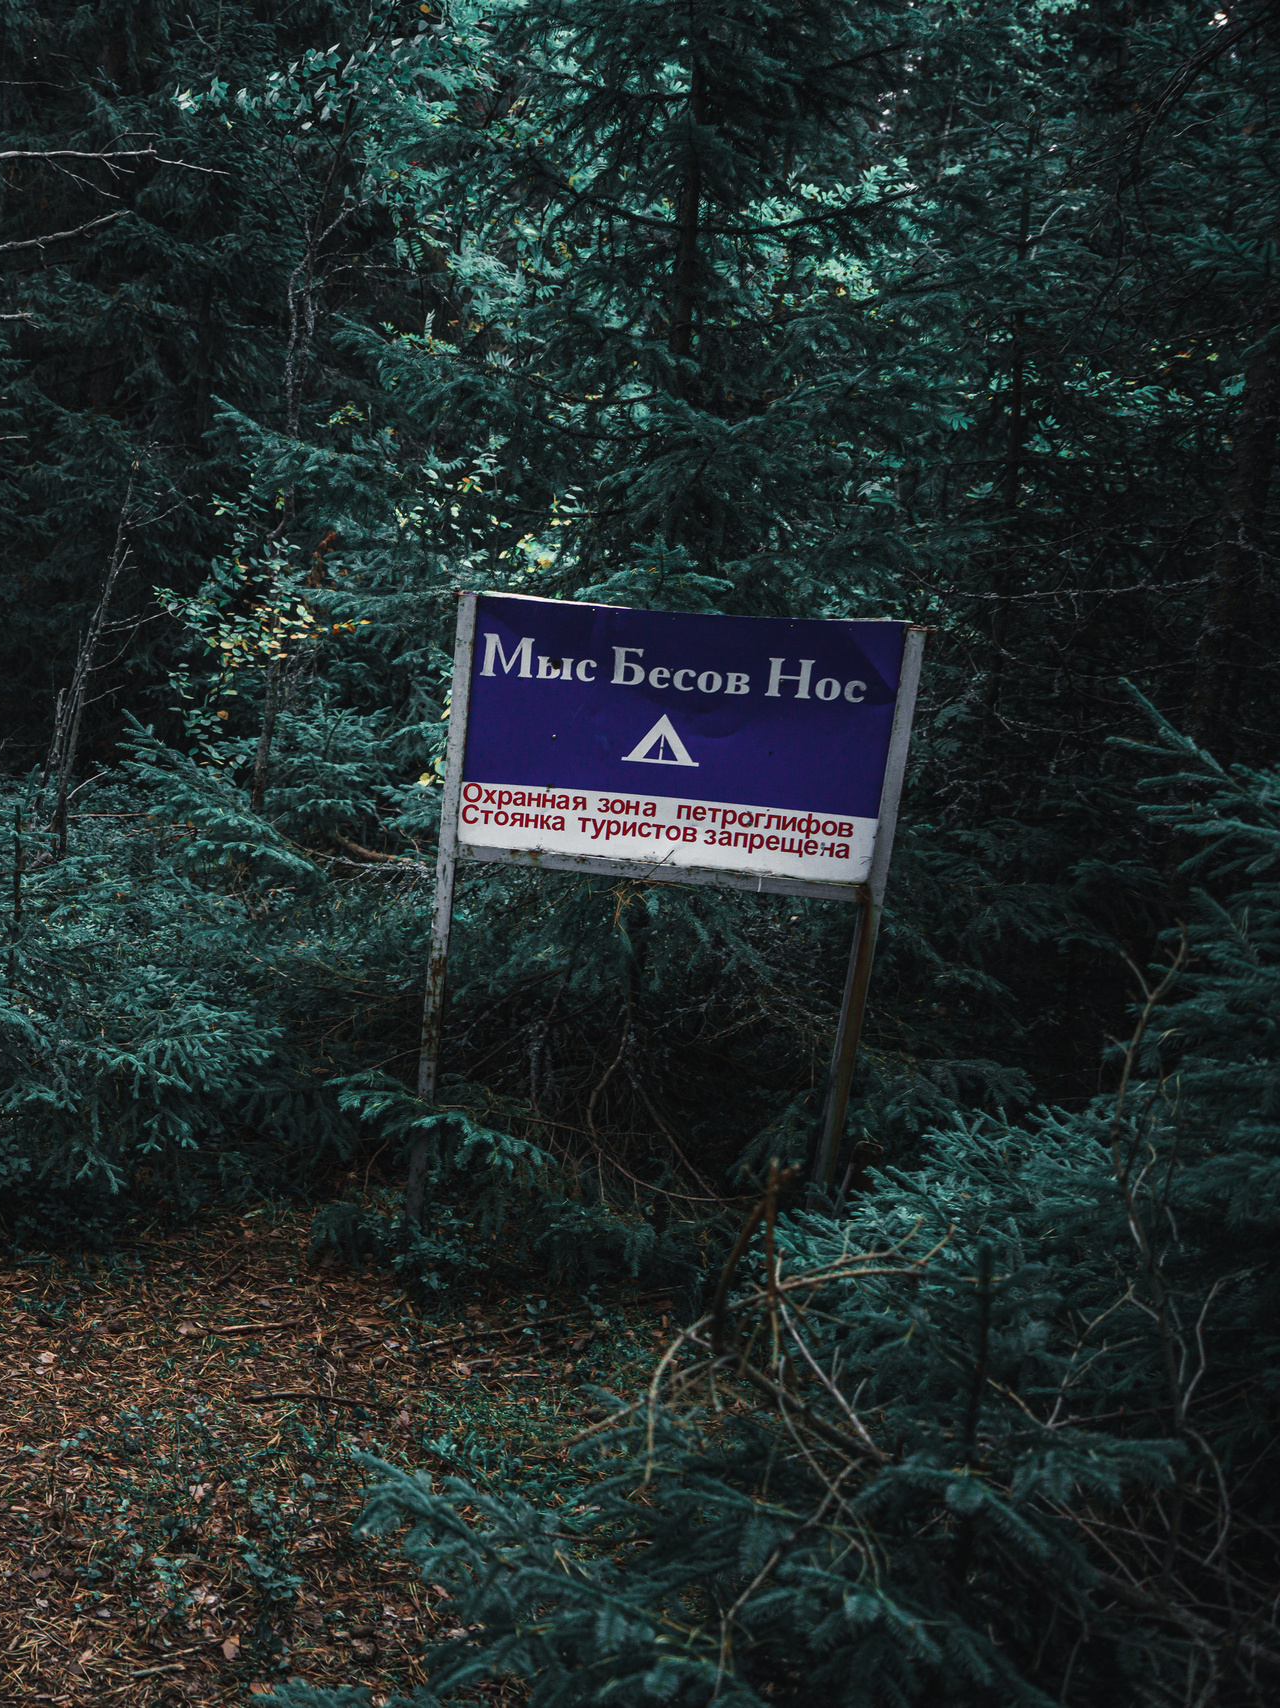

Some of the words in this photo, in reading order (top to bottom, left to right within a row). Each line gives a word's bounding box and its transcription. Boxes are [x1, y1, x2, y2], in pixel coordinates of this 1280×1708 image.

[479, 633, 598, 683] Мыс
[610, 646, 751, 696] Бесов
[764, 657, 868, 704] Нос
[461, 804, 565, 831] Стоянка
[578, 815, 697, 842] туристов
[703, 828, 850, 859] запрещена
[462, 782, 587, 811] Охранная
[596, 796, 657, 818] зона
[677, 804, 854, 839] петроглифов
